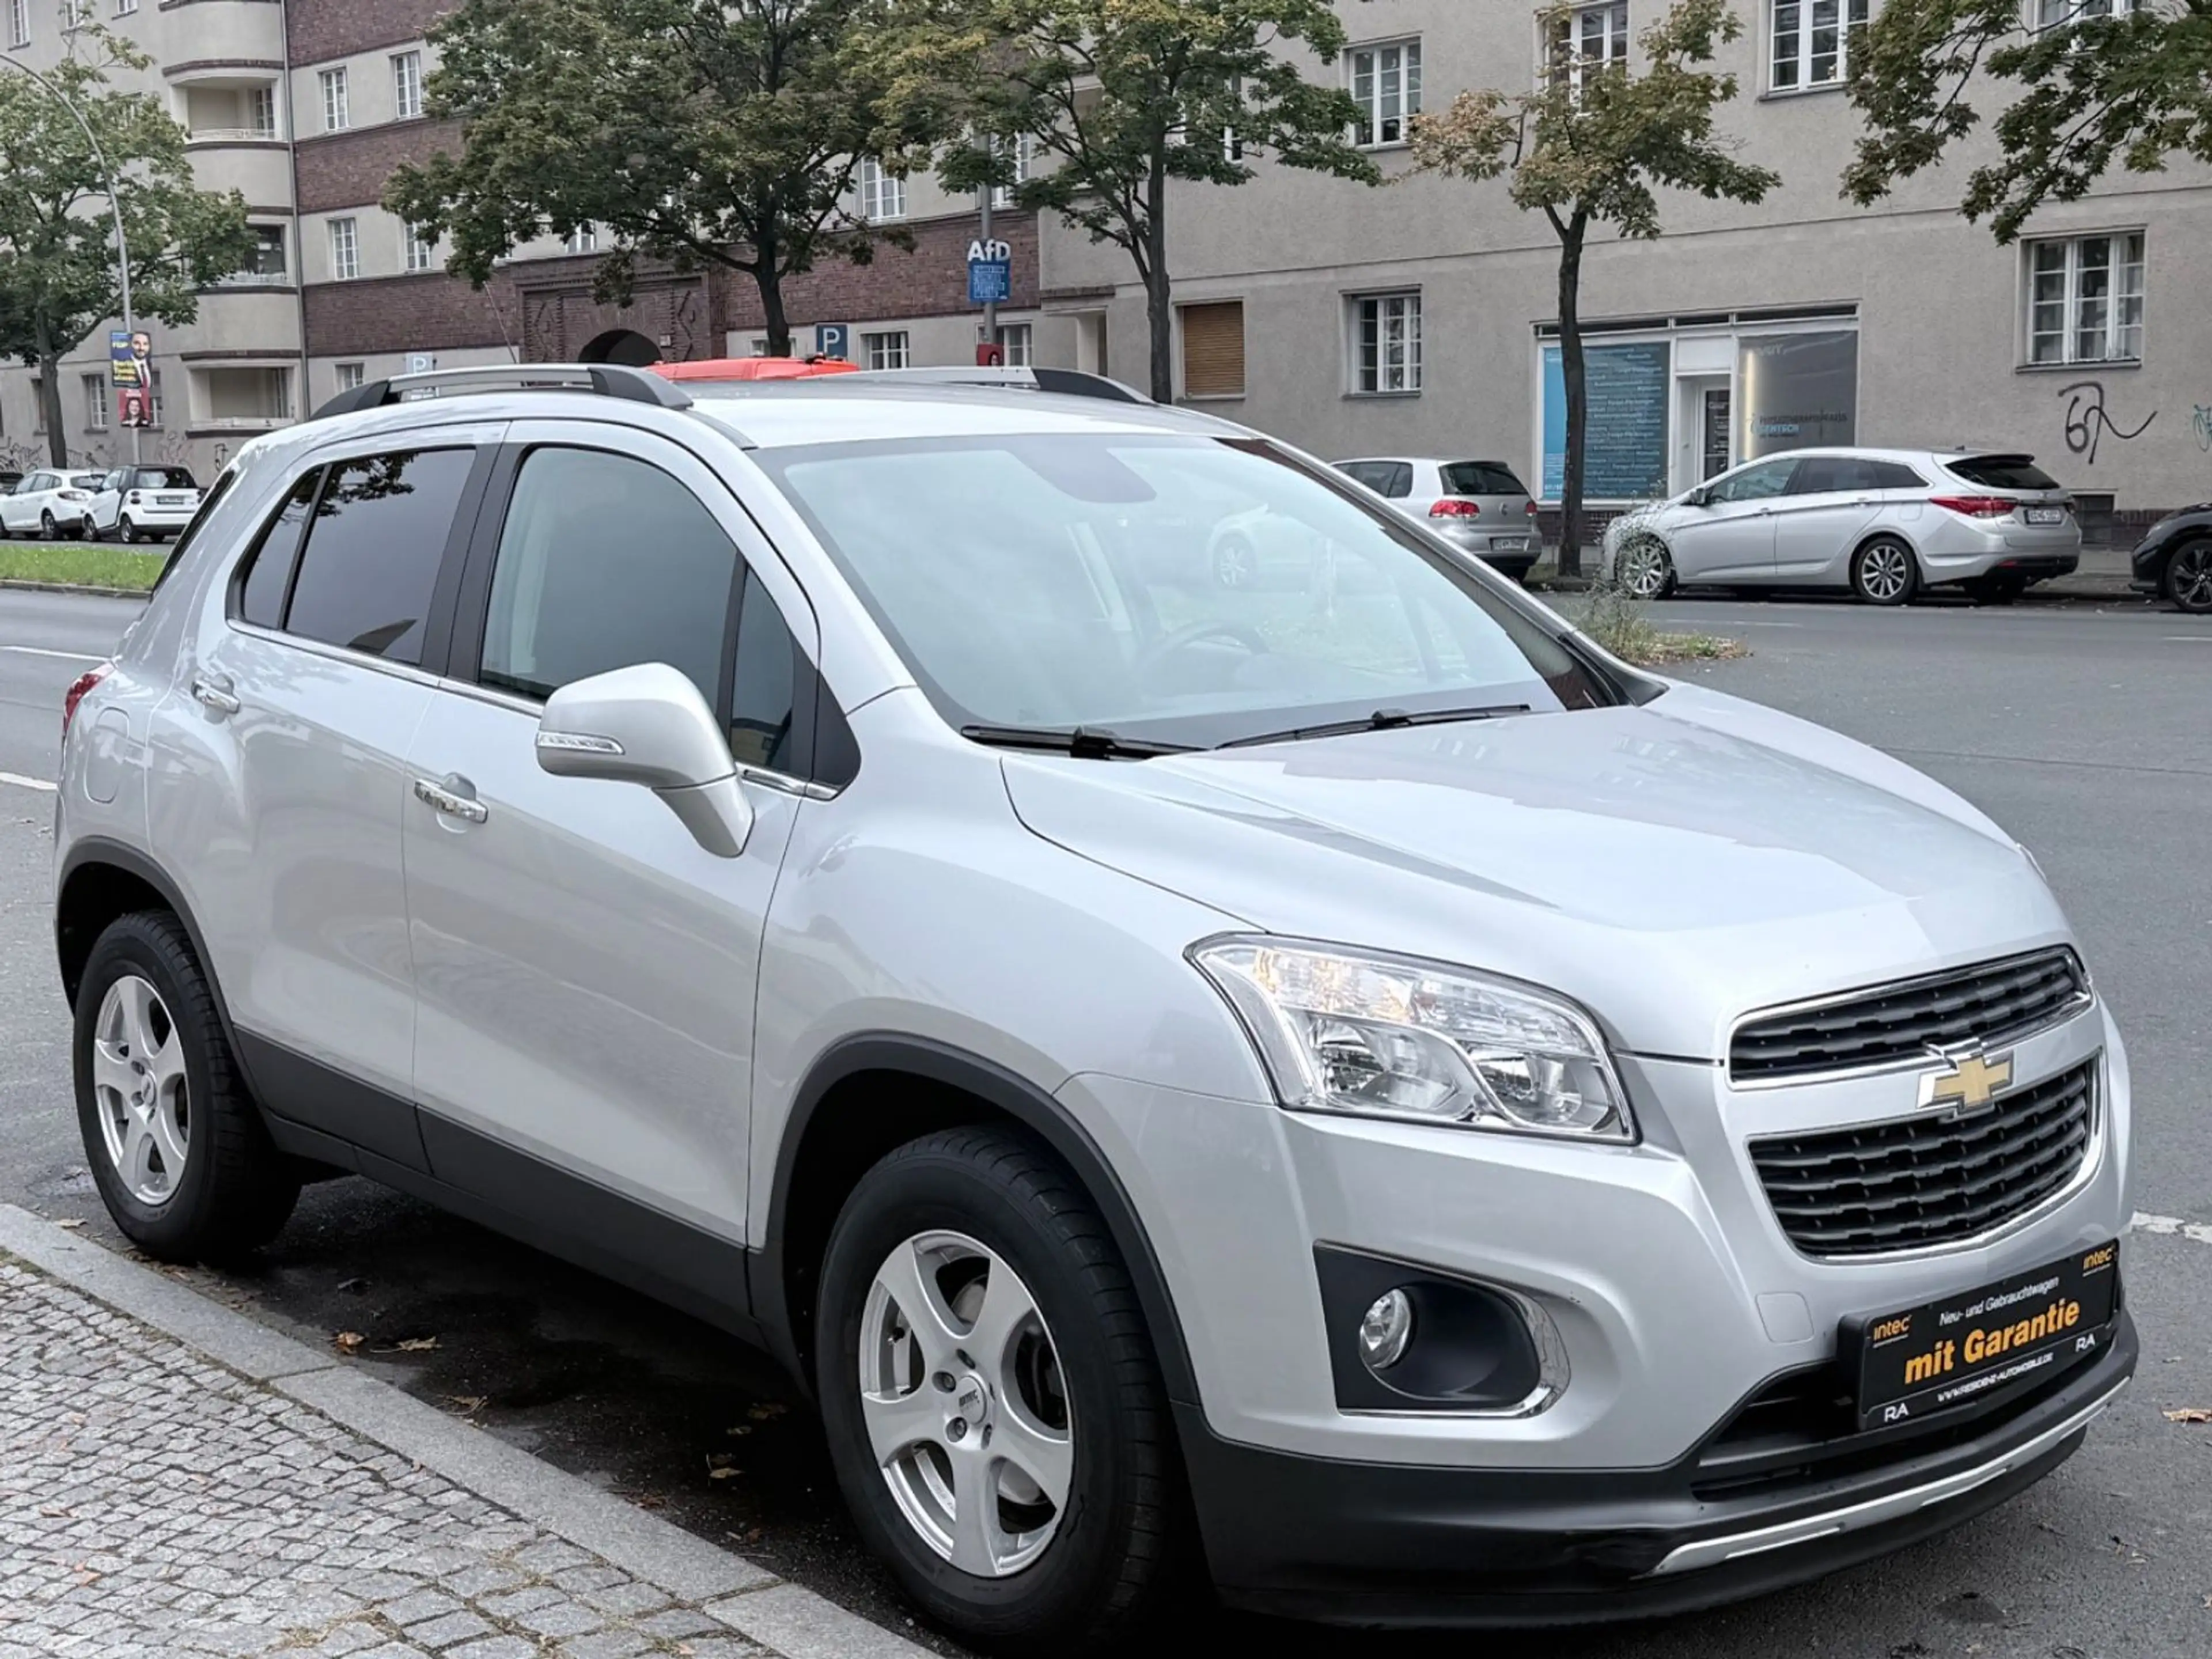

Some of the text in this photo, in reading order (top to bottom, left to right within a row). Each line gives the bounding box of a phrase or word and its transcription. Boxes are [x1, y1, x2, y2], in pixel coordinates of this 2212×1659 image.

[968, 239, 1012, 262] AfD
[823, 328, 840, 353] P
[414, 357, 426, 375] P
[1939, 1277, 2059, 1326] Neu- und Gebrauchtwagen
[1905, 1298, 2080, 1385] mit Garantie
[2075, 1333, 2095, 1352] RA
[1884, 1403, 1909, 1423] RA
